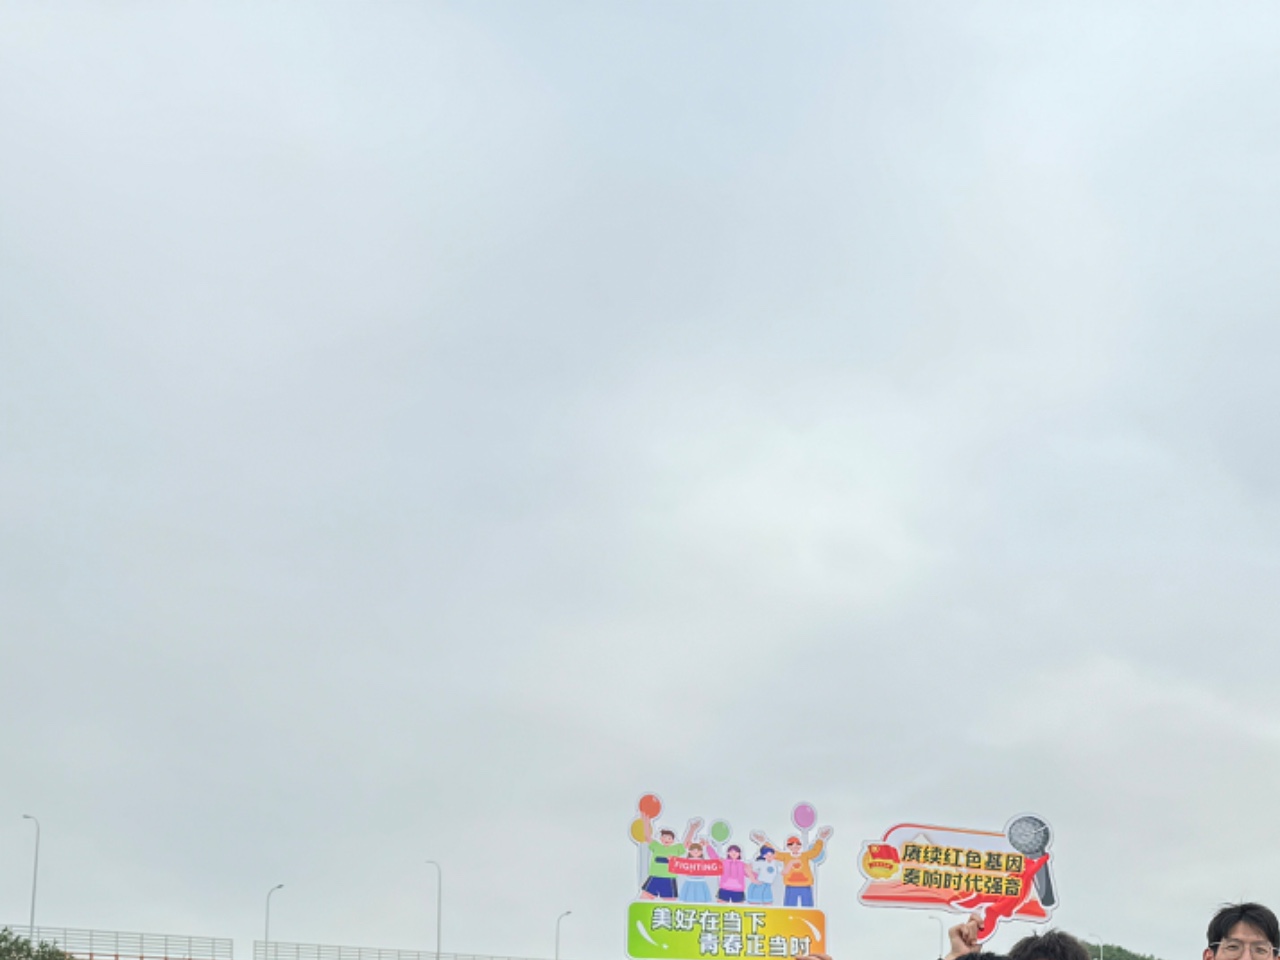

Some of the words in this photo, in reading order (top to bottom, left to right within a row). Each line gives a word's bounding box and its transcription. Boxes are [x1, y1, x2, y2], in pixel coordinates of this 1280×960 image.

[673, 860, 718, 871] FIGHTING
[902, 844, 1023, 872] 赓续红色基因
[902, 868, 1022, 896] 奏响时代强音
[650, 907, 767, 933] 美好在当下
[698, 930, 811, 957] 青春正当时
